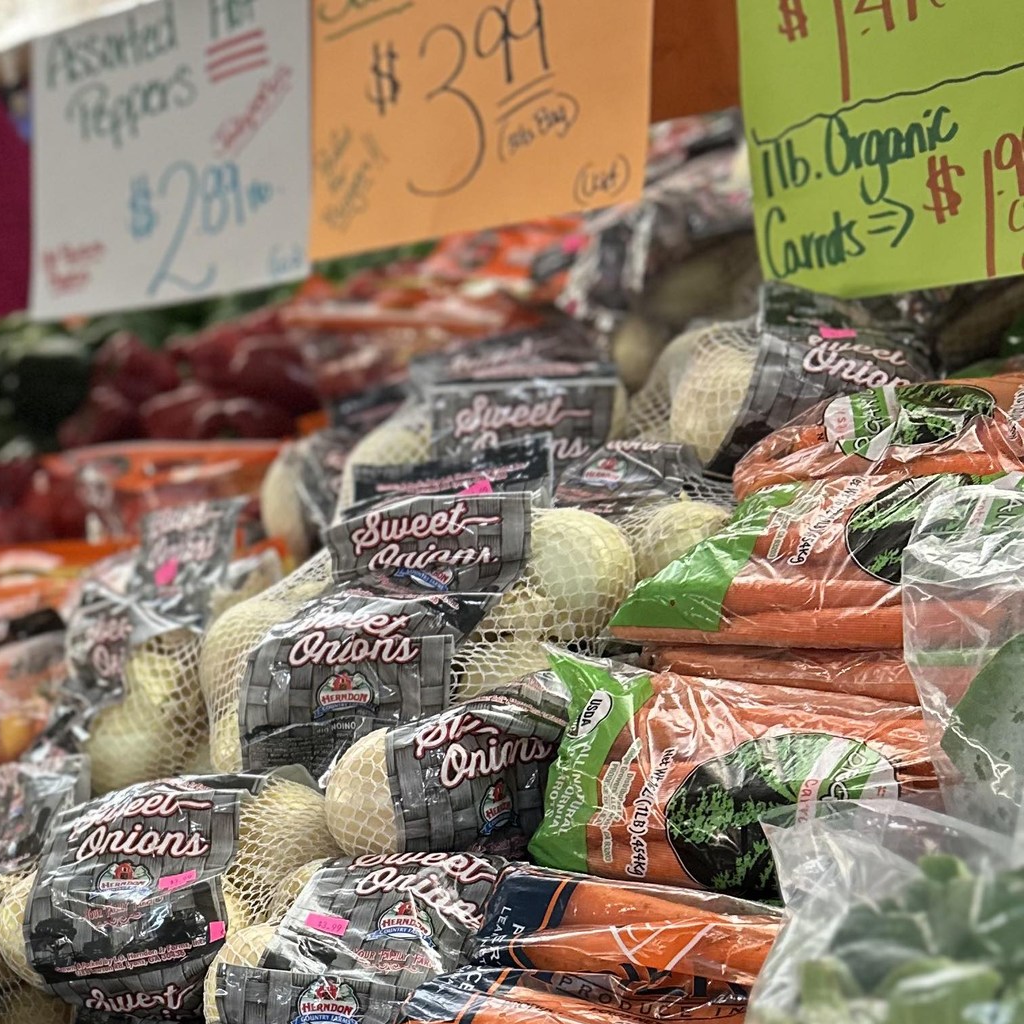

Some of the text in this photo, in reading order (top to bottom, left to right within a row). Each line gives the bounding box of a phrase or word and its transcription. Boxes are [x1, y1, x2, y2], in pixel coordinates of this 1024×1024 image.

[825, 106, 959, 205] Organic
[764, 205, 866, 279] Carrots
[455, 395, 591, 437] Sweet
[350, 499, 503, 556] Sweet
[287, 630, 422, 668] Onions
[321, 692, 369, 704] HERNDON
[580, 697, 603, 727] USDA
[76, 824, 210, 861] Onions
[302, 1002, 354, 1016] HERNDON
